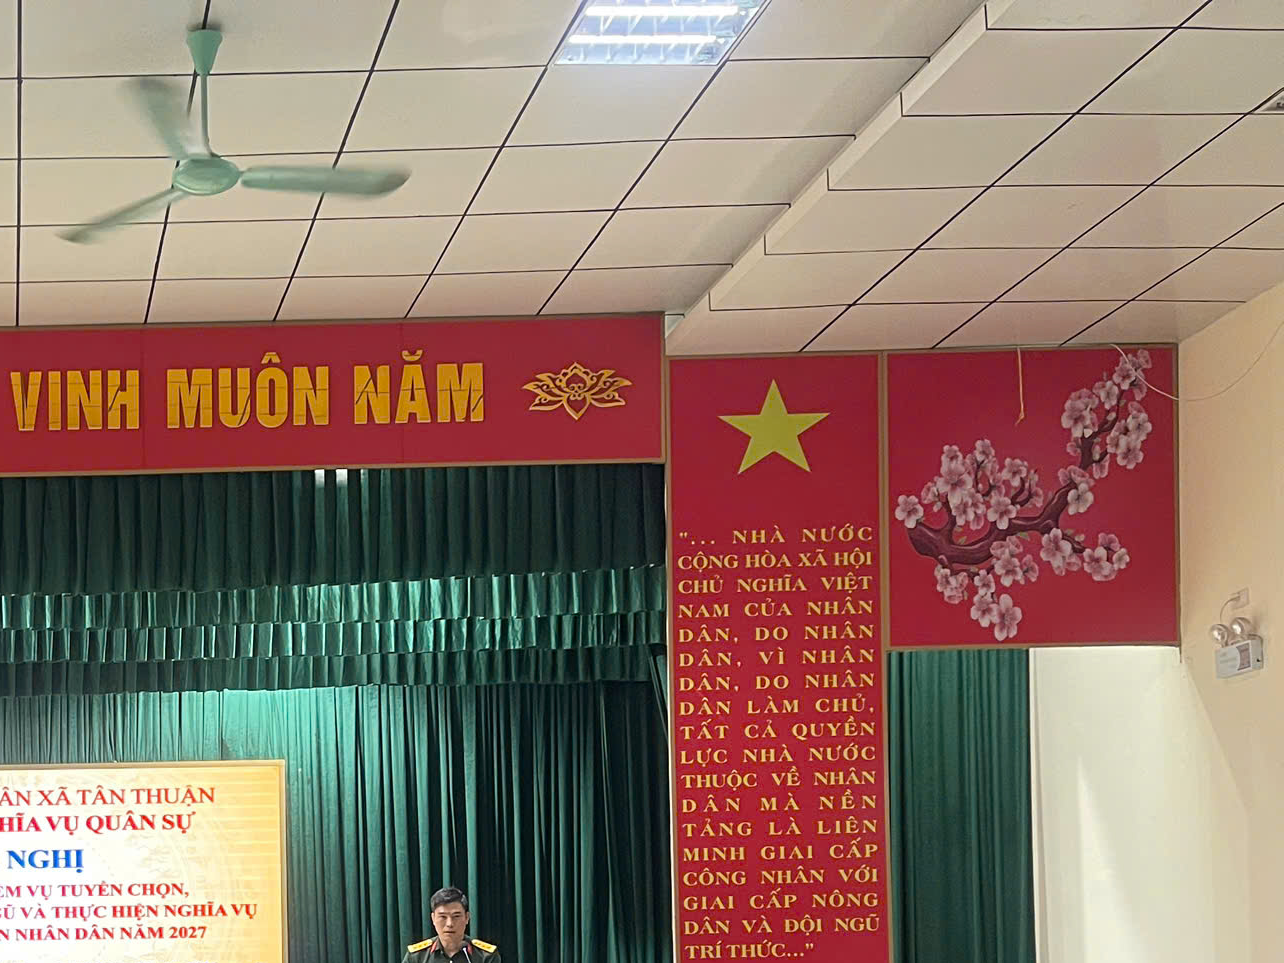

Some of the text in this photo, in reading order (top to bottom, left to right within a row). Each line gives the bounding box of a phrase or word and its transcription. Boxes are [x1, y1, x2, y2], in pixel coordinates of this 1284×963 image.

[10, 369, 141, 432] VINH
[166, 351, 330, 429] MUÔN
[354, 349, 487, 425] NĂM
[732, 525, 785, 544] NHÀ
[802, 523, 873, 543] NƯỚC
[678, 547, 872, 573] CỘNG HÒA XÃ HỘI
[678, 572, 873, 594] CHỦ NGHĨA VIỆT
[678, 597, 873, 618] NAM CỦA NHÂN
[679, 621, 874, 644] DÂN, DO NHÂN
[679, 645, 874, 668] DÂN, VÌ NHÂN
[679, 669, 874, 692] DÂN, DO NHÂN
[679, 697, 731, 716] DÂN
[747, 696, 799, 714] LÀM
[680, 715, 876, 741] TẤT CẢ QUYỀN
[680, 743, 876, 768] LỰC NHÀ NƯỚC
[681, 765, 876, 791] THUỘC VỀ NHÂN
[37, 786, 72, 806] XÃ
[77, 784, 125, 805] TÂN
[130, 784, 215, 807] THUẬN
[682, 788, 877, 813] DÂN MÀ NỀN
[45, 815, 79, 835] VỤ
[85, 810, 156, 834] QUÂN
[162, 811, 196, 834] SỰ
[682, 815, 877, 837] TẢNG LÀ LIÊN
[8, 848, 84, 873] NGHỊ
[683, 837, 878, 862] MINH GIAI CẤP
[683, 865, 878, 886] CÔNG NHÂN VỚI
[27, 885, 52, 900] VỤ
[128, 883, 189, 899] CHỌN,
[683, 888, 878, 911] GIAI CẤP NÔNG
[20, 903, 46, 919] VÀ
[52, 903, 107, 921] THỰC
[111, 903, 159, 921] HIỆN
[164, 901, 228, 917] NGHĨA
[231, 903, 258, 920] VỤ
[15, 925, 70, 941] NHÂN
[75, 924, 115, 940] DÂN
[120, 924, 164, 940] NĂM
[169, 926, 207, 939] 2027
[684, 914, 880, 936] DÂN VÀ ĐỘI NGŨ
[684, 941, 721, 960] TRÍ
